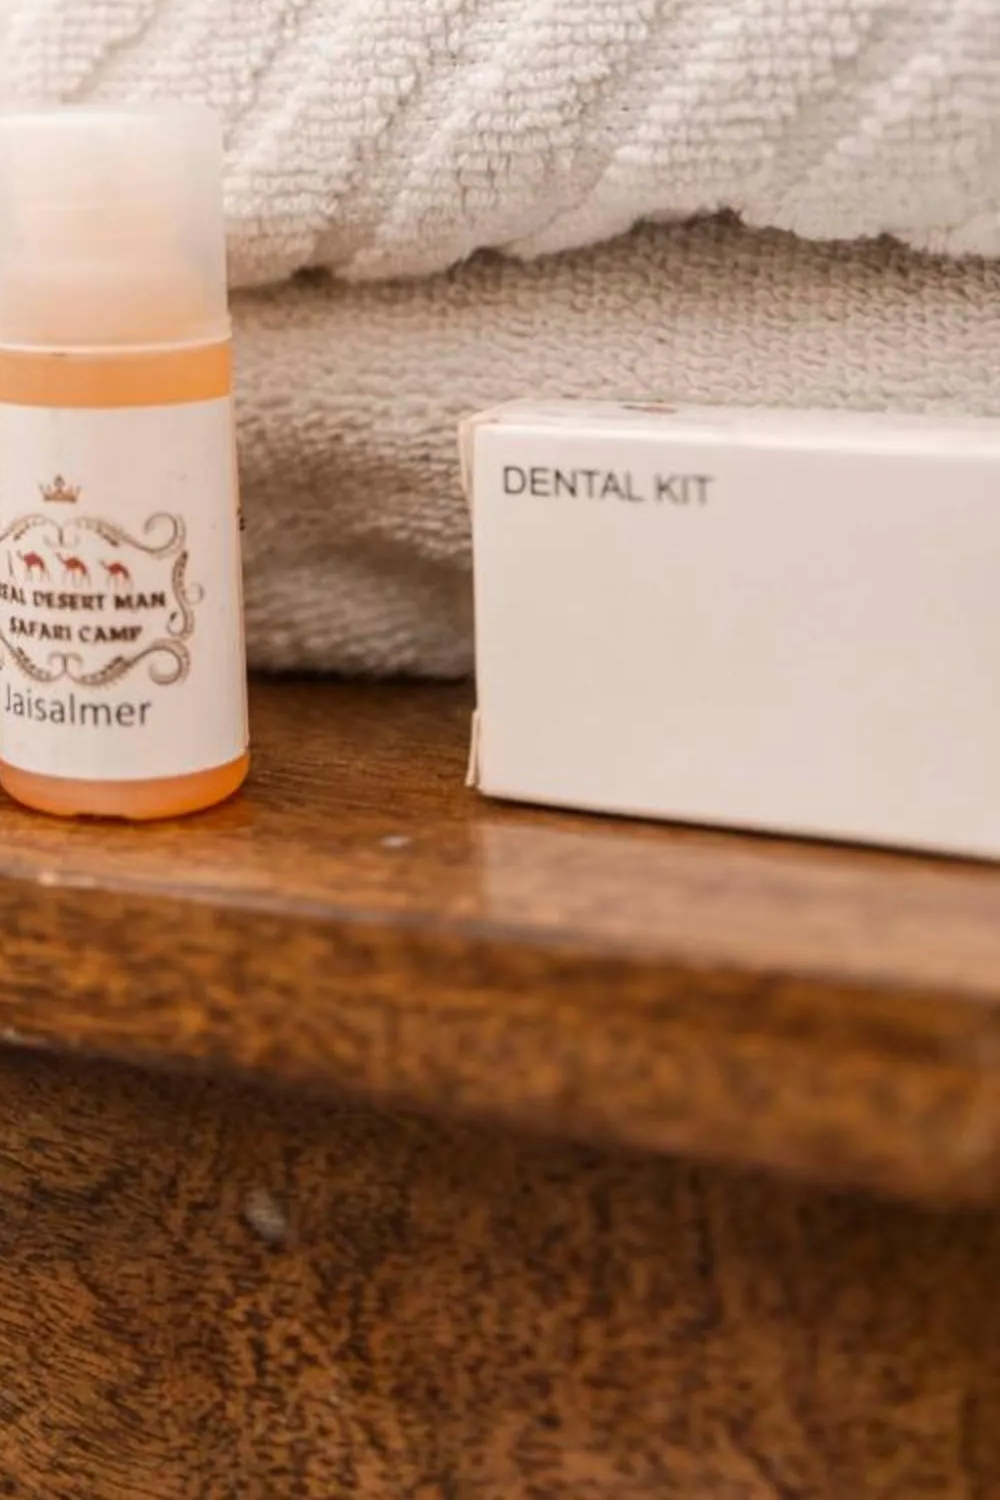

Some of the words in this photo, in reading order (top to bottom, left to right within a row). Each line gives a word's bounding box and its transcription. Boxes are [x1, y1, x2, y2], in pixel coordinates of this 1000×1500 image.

[503, 465, 645, 503] DENTAL
[653, 472, 716, 507] KIT
[31, 590, 105, 612] DESERT
[113, 591, 166, 609] MAN
[9, 615, 72, 643] SAFARI
[77, 626, 144, 645] CAMP
[5, 682, 152, 728] Jaisalmer
